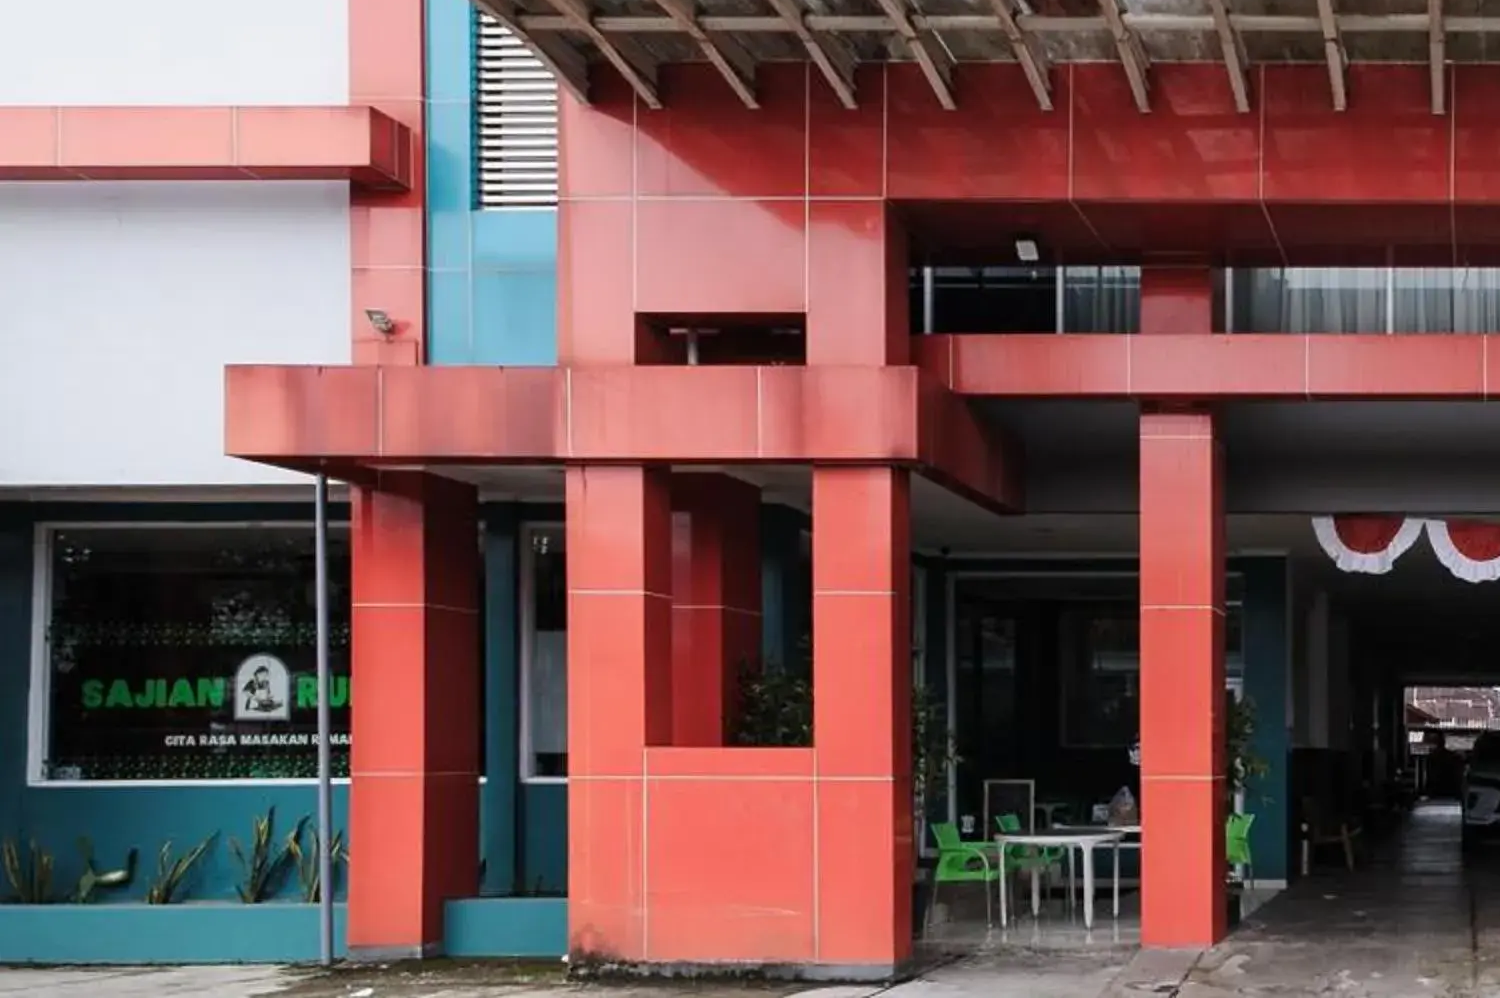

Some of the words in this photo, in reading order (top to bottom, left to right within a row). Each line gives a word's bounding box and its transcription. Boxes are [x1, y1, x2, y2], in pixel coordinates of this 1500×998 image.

[82, 679, 225, 708] SAJIAN
[297, 676, 352, 708] RU
[199, 735, 236, 746] RASA
[240, 734, 308, 745] MASAKAN
[311, 734, 352, 745] RMA
